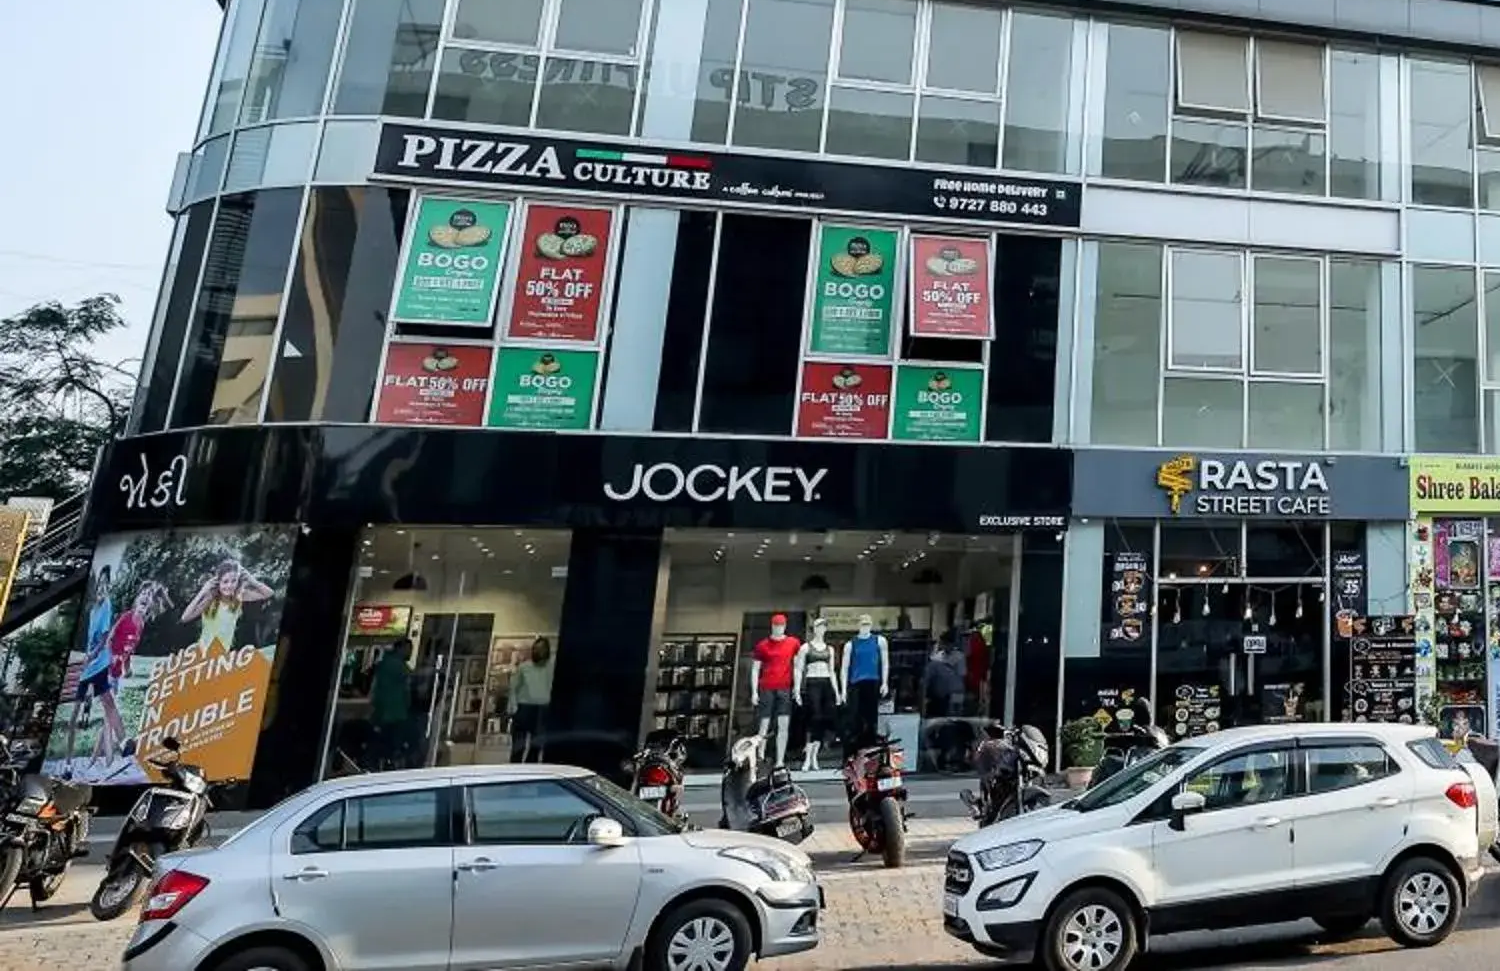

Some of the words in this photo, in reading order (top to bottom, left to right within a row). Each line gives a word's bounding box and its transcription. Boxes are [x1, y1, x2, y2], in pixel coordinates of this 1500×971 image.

[398, 134, 567, 179] PIZZA
[573, 162, 711, 190] CULTURE
[949, 197, 986, 211] 9727
[990, 200, 1017, 214] 880
[1021, 203, 1048, 216] 443
[417, 252, 489, 270] BOGO
[540, 267, 583, 281] FLAT
[526, 281, 559, 297] 50%
[565, 283, 593, 299] OFF
[824, 282, 885, 299] BOGO
[934, 280, 970, 290] FLAT
[923, 290, 953, 303] 50%
[957, 293, 981, 305] OFF
[384, 375, 427, 387] FLAT
[428, 378, 458, 391] 50%
[463, 379, 487, 392] OFF
[519, 374, 572, 388] BOGO
[802, 392, 836, 404] FLAT
[867, 394, 888, 406] OFF
[918, 391, 962, 404] BOGO
[602, 463, 828, 502] JOCKEY
[1199, 460, 1329, 490] RASTA
[1416, 475, 1465, 499] Shree
[1197, 496, 1274, 514] STREET
[1277, 496, 1330, 514] CAFE
[979, 515, 1031, 526] EXCLUSIVE
[1033, 516, 1065, 527] STORE
[149, 641, 212, 682] BUSY
[144, 644, 257, 706] GETTING
[135, 688, 257, 756] TROUBLE
[138, 702, 165, 732] IN
